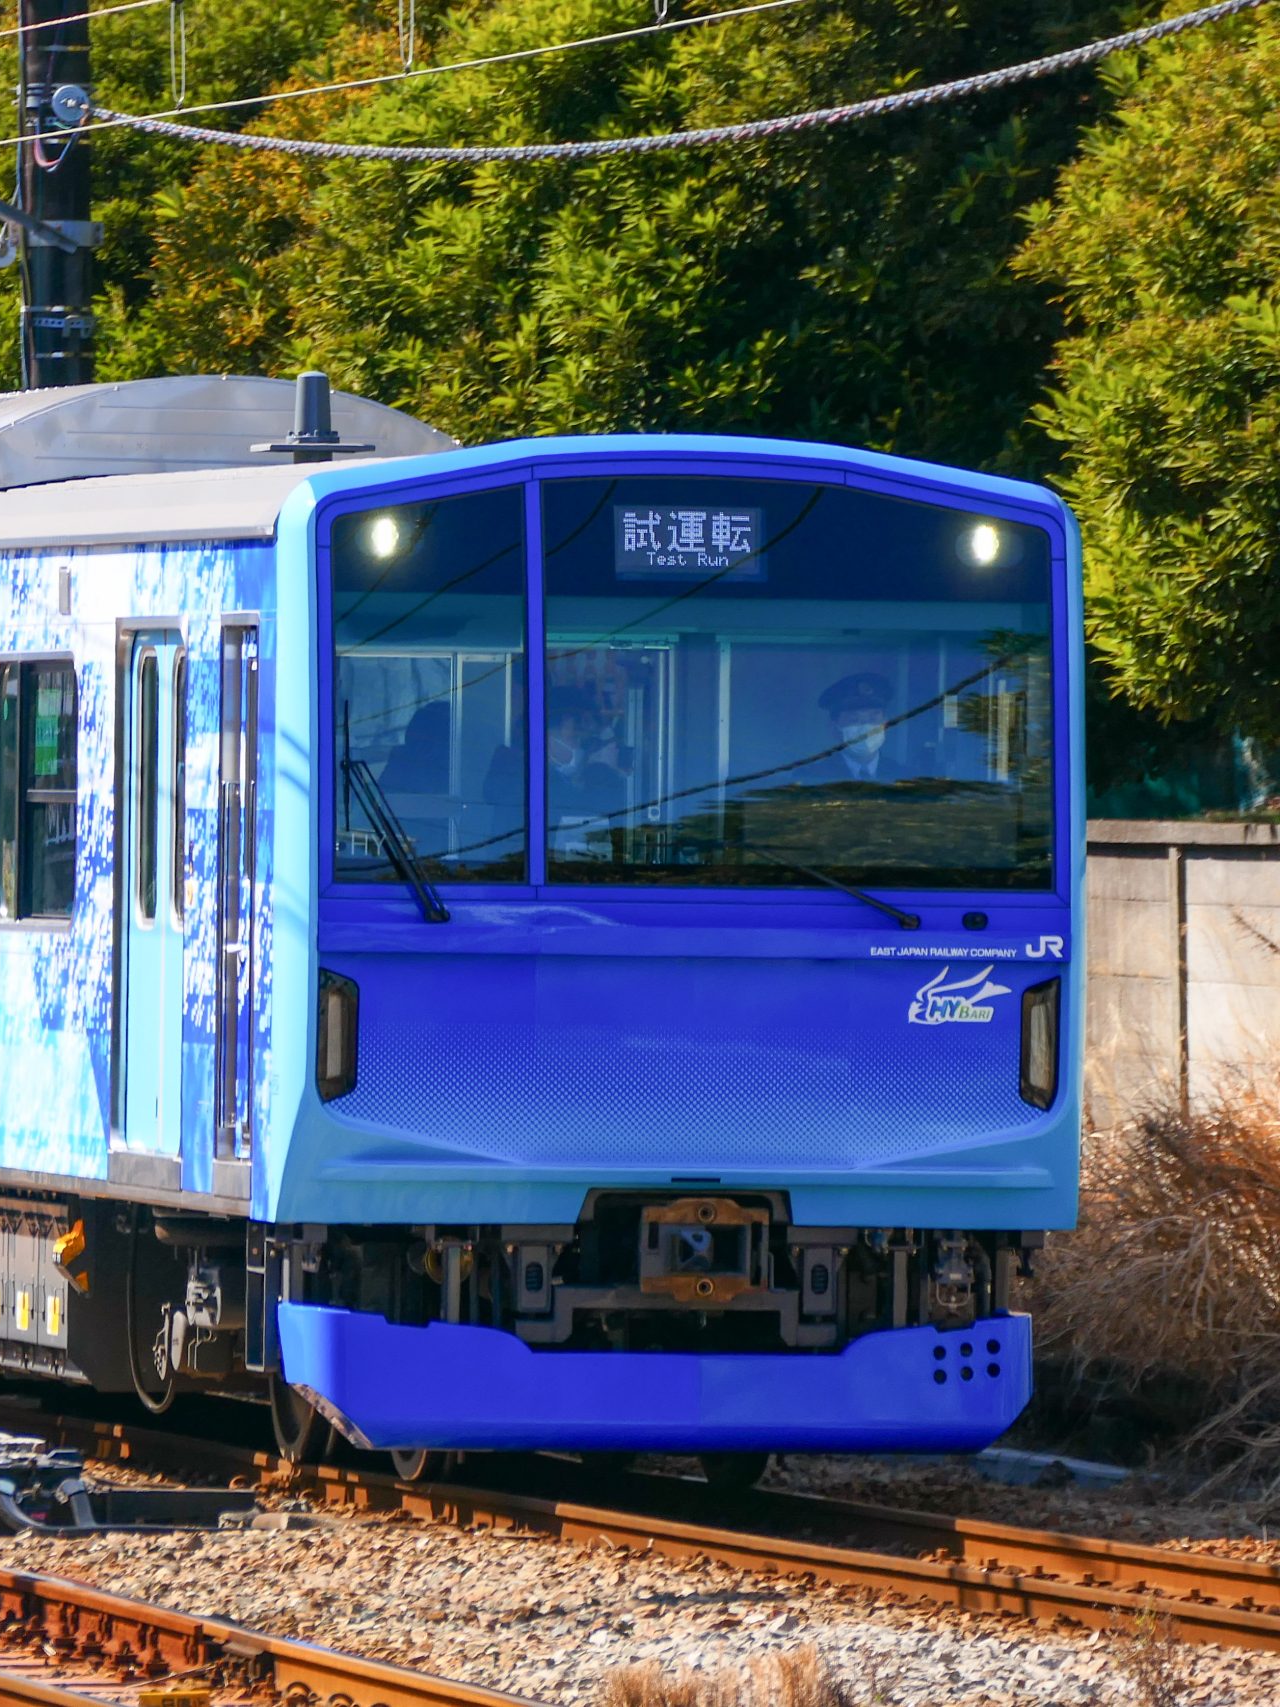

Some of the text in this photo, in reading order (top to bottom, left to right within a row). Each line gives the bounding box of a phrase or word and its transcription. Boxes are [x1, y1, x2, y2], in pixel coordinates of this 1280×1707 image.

[623, 510, 751, 553] 試運転
[646, 551, 729, 567] Test Run
[870, 946, 1017, 958] EAST JAPAN RAILWAY COMPANY
[1025, 935, 1064, 958] JR
